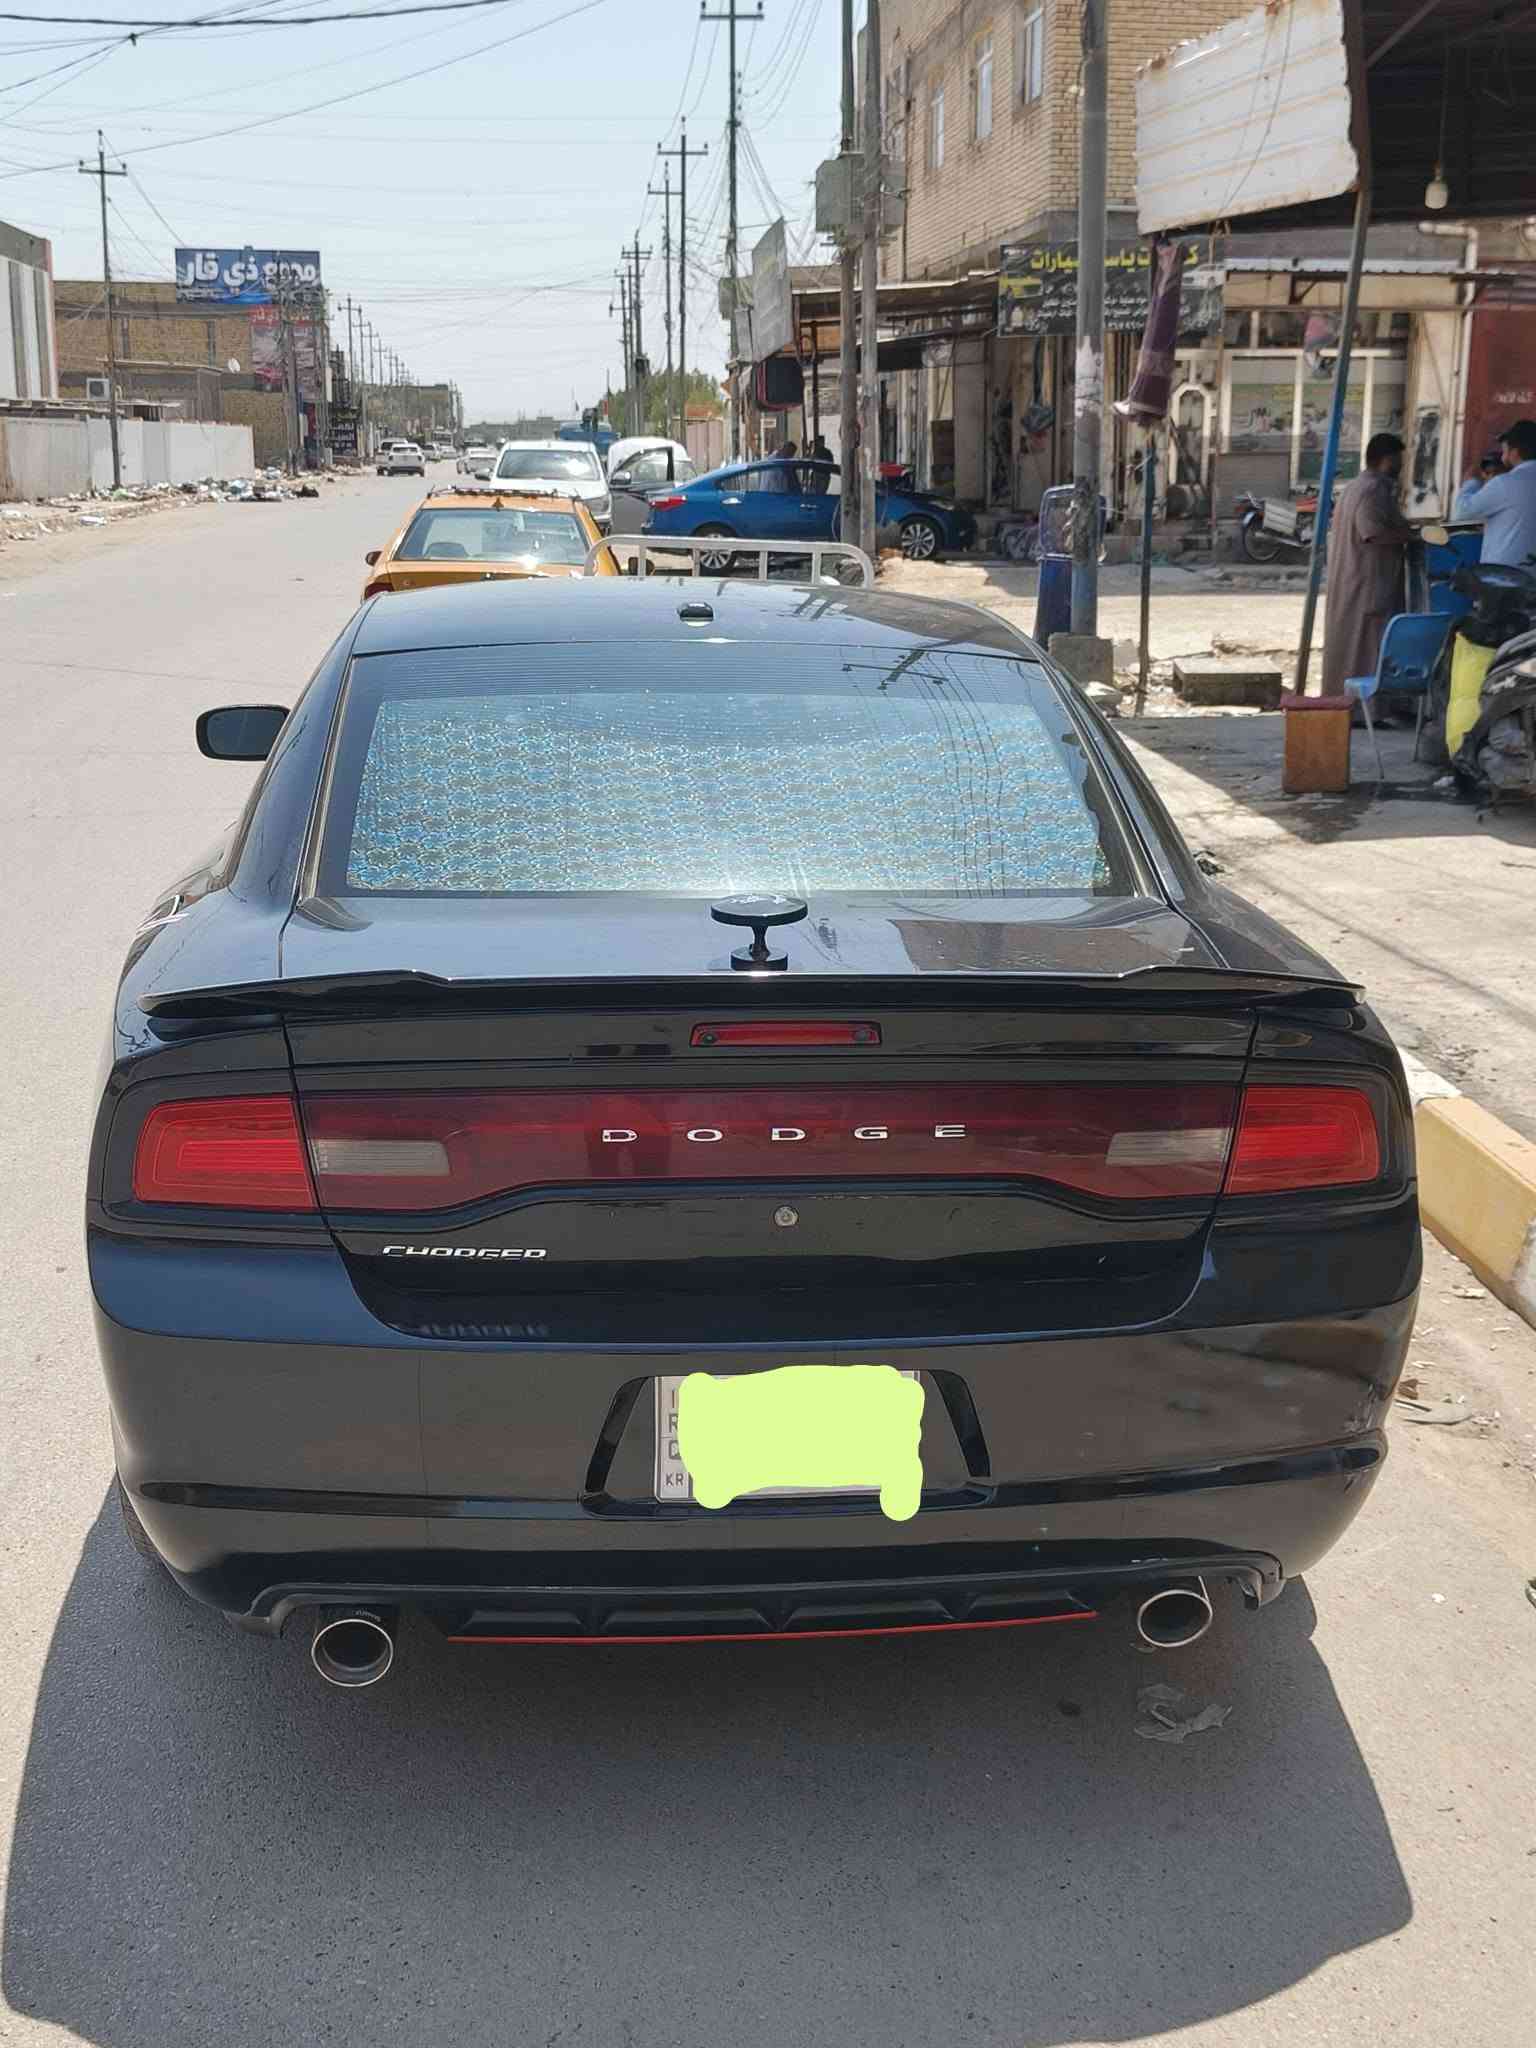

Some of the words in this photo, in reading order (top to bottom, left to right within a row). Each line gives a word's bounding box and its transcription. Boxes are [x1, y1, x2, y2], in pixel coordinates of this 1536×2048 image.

[179, 252, 219, 286] قار
[223, 255, 258, 295] ذي
[602, 1124, 966, 1142] DODGE
[665, 1473, 684, 1486] KR
